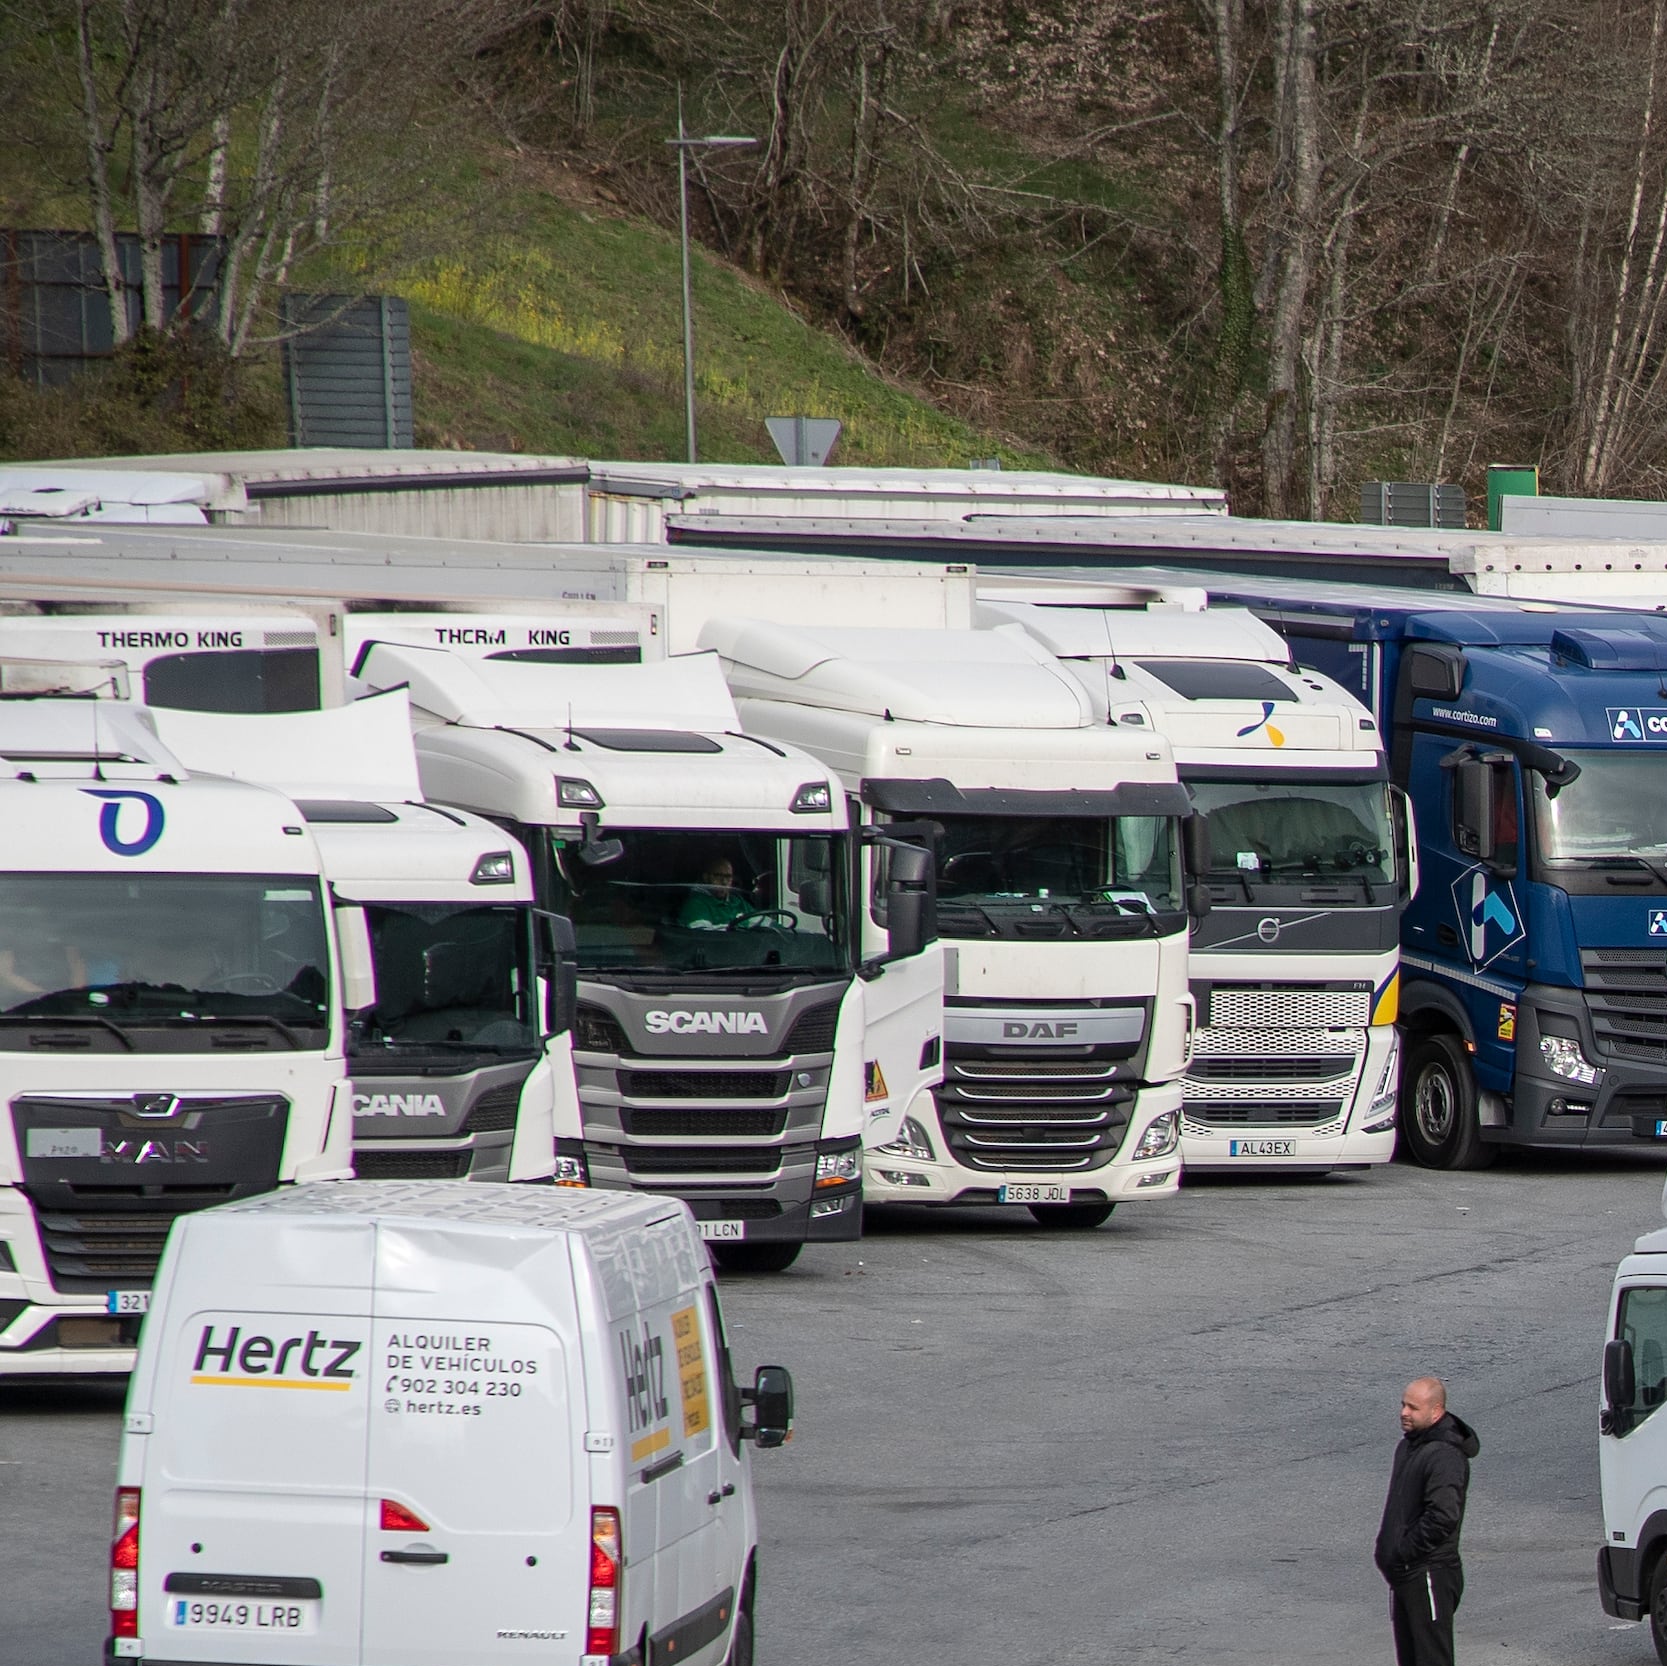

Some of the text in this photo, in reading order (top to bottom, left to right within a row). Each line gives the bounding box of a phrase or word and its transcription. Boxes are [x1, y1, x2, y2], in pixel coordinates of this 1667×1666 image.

[97, 631, 243, 649] THERMO KING
[528, 629, 570, 646] KING
[1432, 706, 1497, 728] www.cortizo.com
[644, 1010, 768, 1034] SCANIA
[1003, 1022, 1078, 1039] DAF
[352, 1094, 446, 1117] CANIA
[100, 1140, 209, 1164] MAN
[1007, 1185, 1068, 1202] 5638 JDL
[713, 1223, 739, 1237] LCN
[387, 1334, 491, 1351] ALQUILER
[193, 1325, 362, 1379] Hertz
[387, 1353, 537, 1374] DE VEHÍCULOS
[620, 1321, 669, 1433] Hertz
[400, 1378, 521, 1397] 902 304 230
[406, 1400, 482, 1415] hertz.es
[201, 1580, 283, 1594] MASTER
[190, 1604, 301, 1628] 9949 LRB
[496, 1630, 568, 1640] RENAULT
